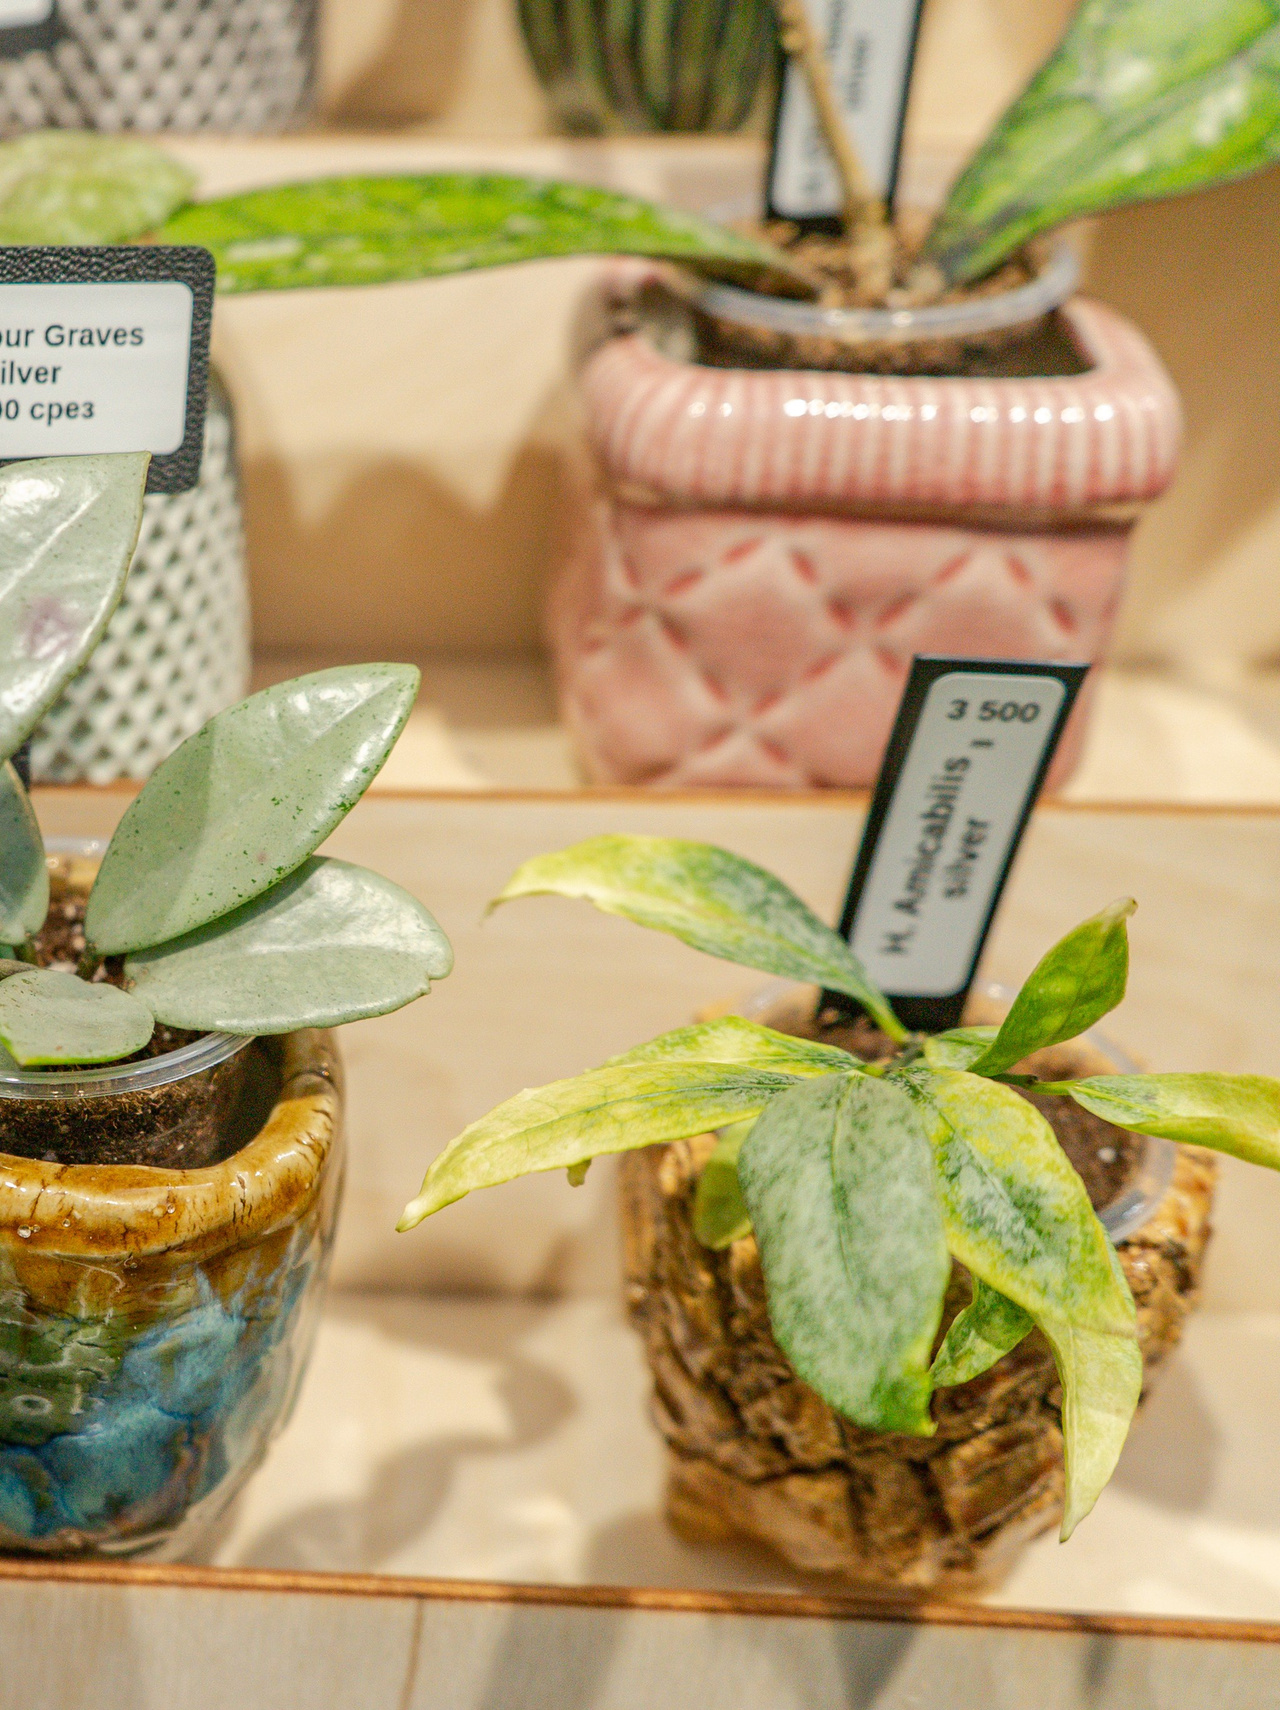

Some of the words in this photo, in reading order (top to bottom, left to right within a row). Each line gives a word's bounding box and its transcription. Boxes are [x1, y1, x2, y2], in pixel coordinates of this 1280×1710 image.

[44, 323, 145, 347] Graves
[946, 698, 969, 721] 3
[977, 699, 1041, 723] 500
[894, 755, 971, 917] Amicabilis
[944, 817, 990, 899] silver
